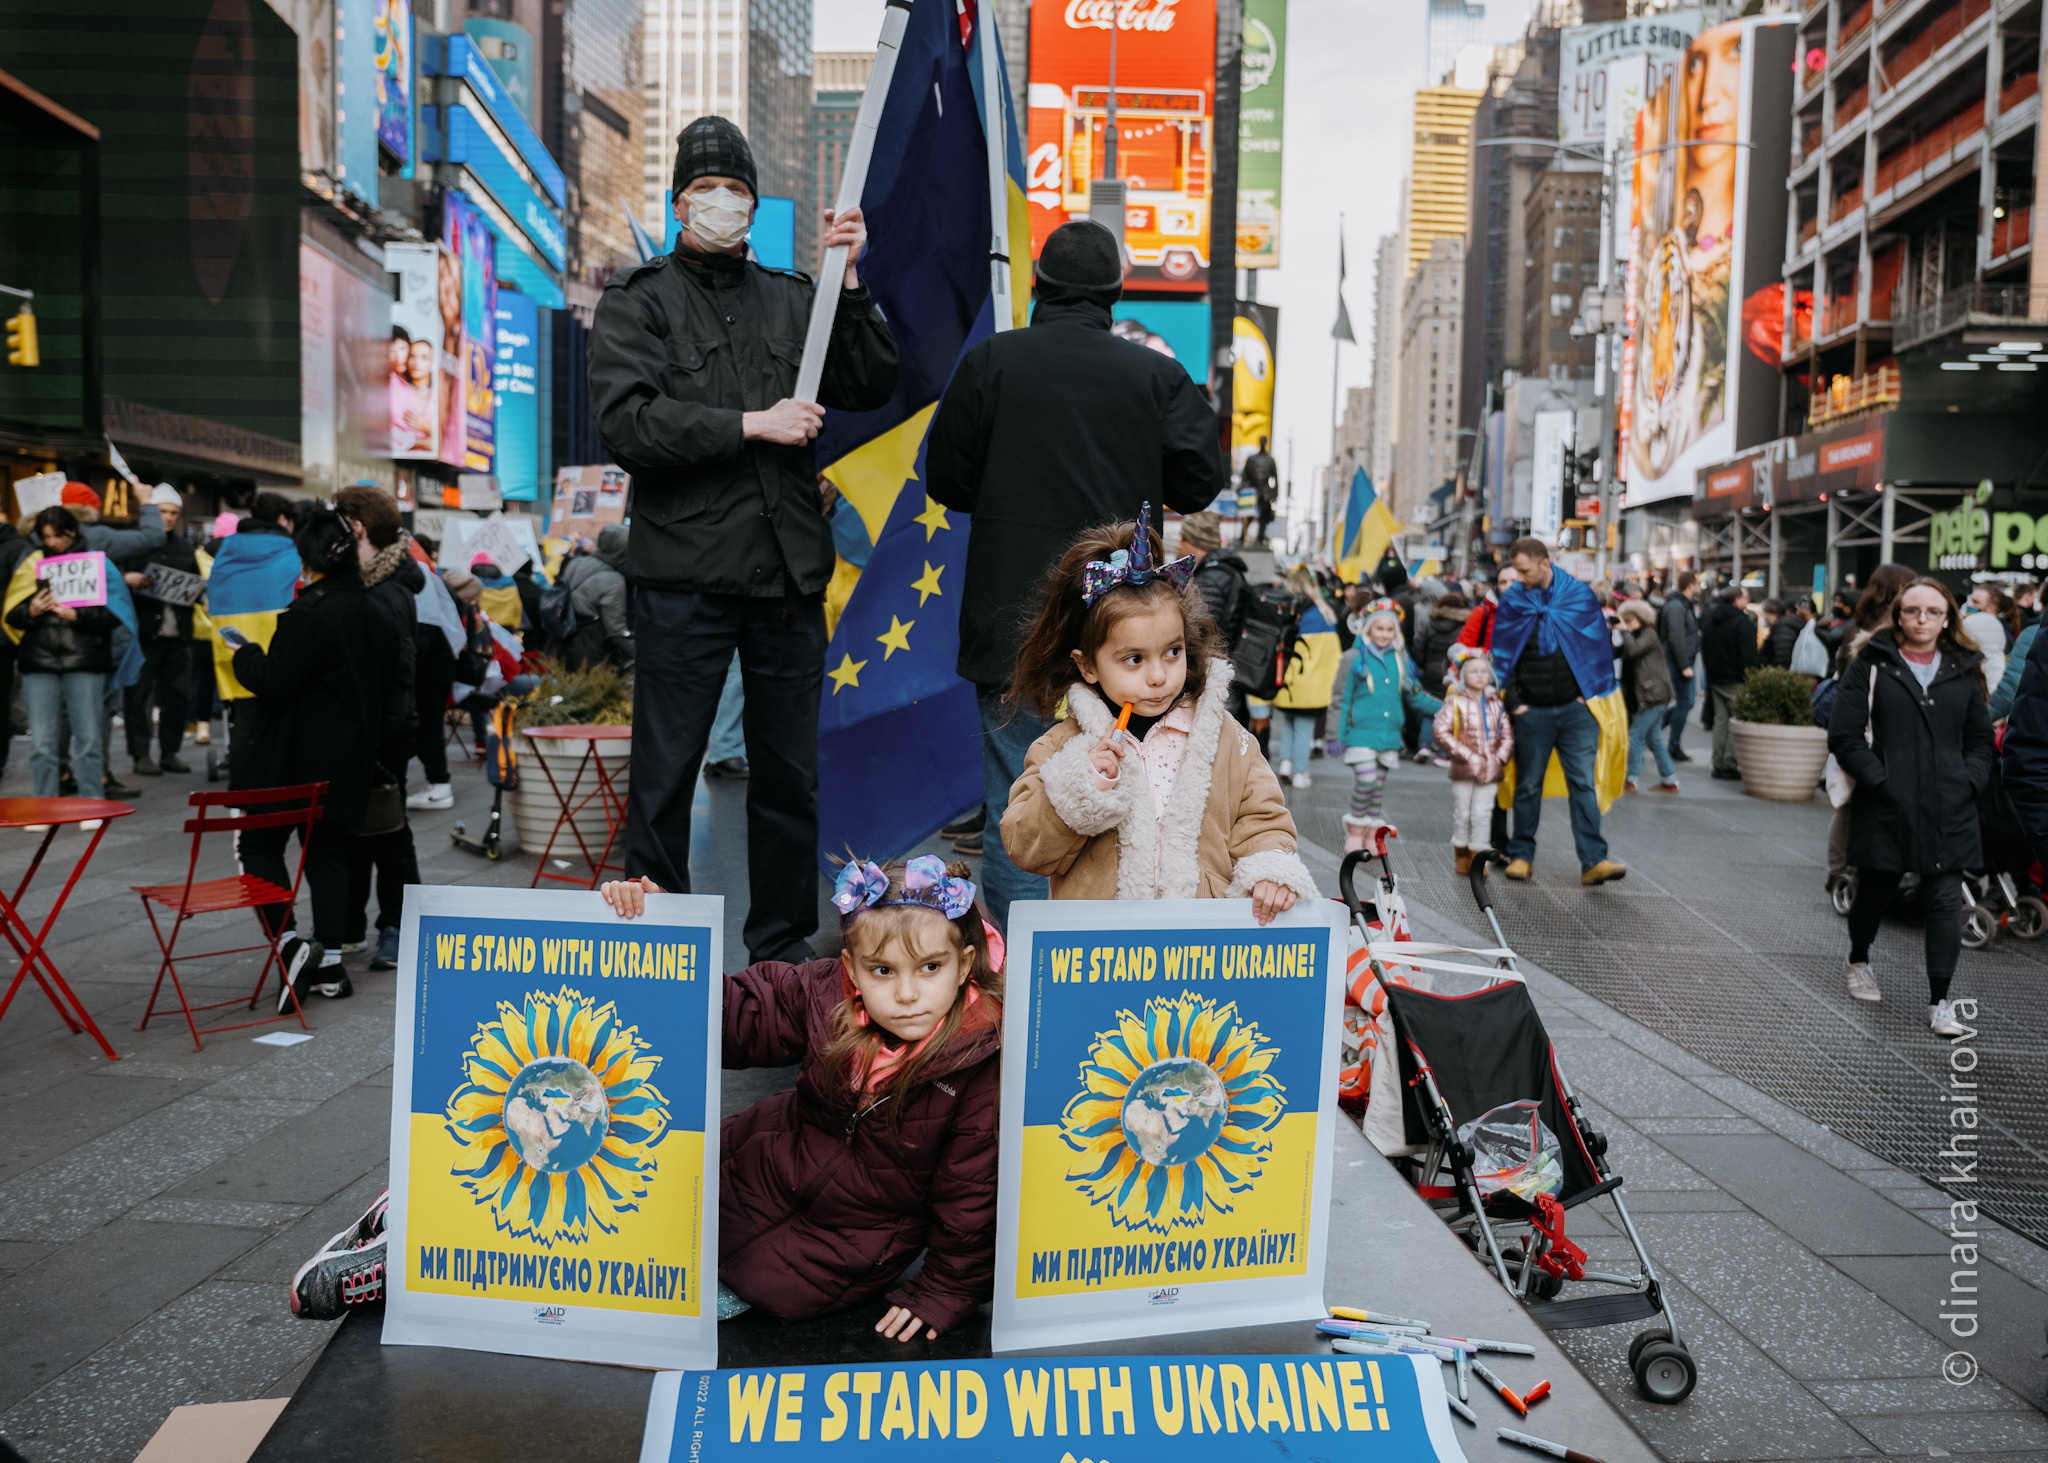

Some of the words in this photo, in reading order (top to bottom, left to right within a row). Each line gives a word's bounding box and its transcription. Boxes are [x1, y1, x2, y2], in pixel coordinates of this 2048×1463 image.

[1578, 26, 1641, 64] LITTLE
[45, 560, 93, 580] STOP
[436, 933, 466, 971] WE
[471, 935, 537, 974] STAND
[542, 938, 595, 976] WITH
[600, 940, 697, 981] UKRAINE!
[1051, 948, 1083, 984] WE
[1088, 946, 1157, 983] STAND
[1163, 945, 1216, 981] WITH
[1221, 943, 1316, 980] UKRAINE!
[420, 1245, 448, 1281] МИ
[454, 1248, 592, 1293] ПІДТРИМУЄМО
[598, 1257, 687, 1301] УКРАЇНУ!
[1031, 1250, 1061, 1284] МИ
[1067, 1239, 1207, 1286] ПІДТРИМУЄМО
[1211, 1229, 1296, 1269] УКРАЇНУ!
[697, 1375, 711, 1403] ©2022
[728, 1373, 805, 1443] WE
[821, 1370, 989, 1442] STAND
[1004, 1367, 1136, 1437] WITH
[1150, 1362, 1389, 1435] UKRAINE!
[694, 1406, 706, 1427] ALL
